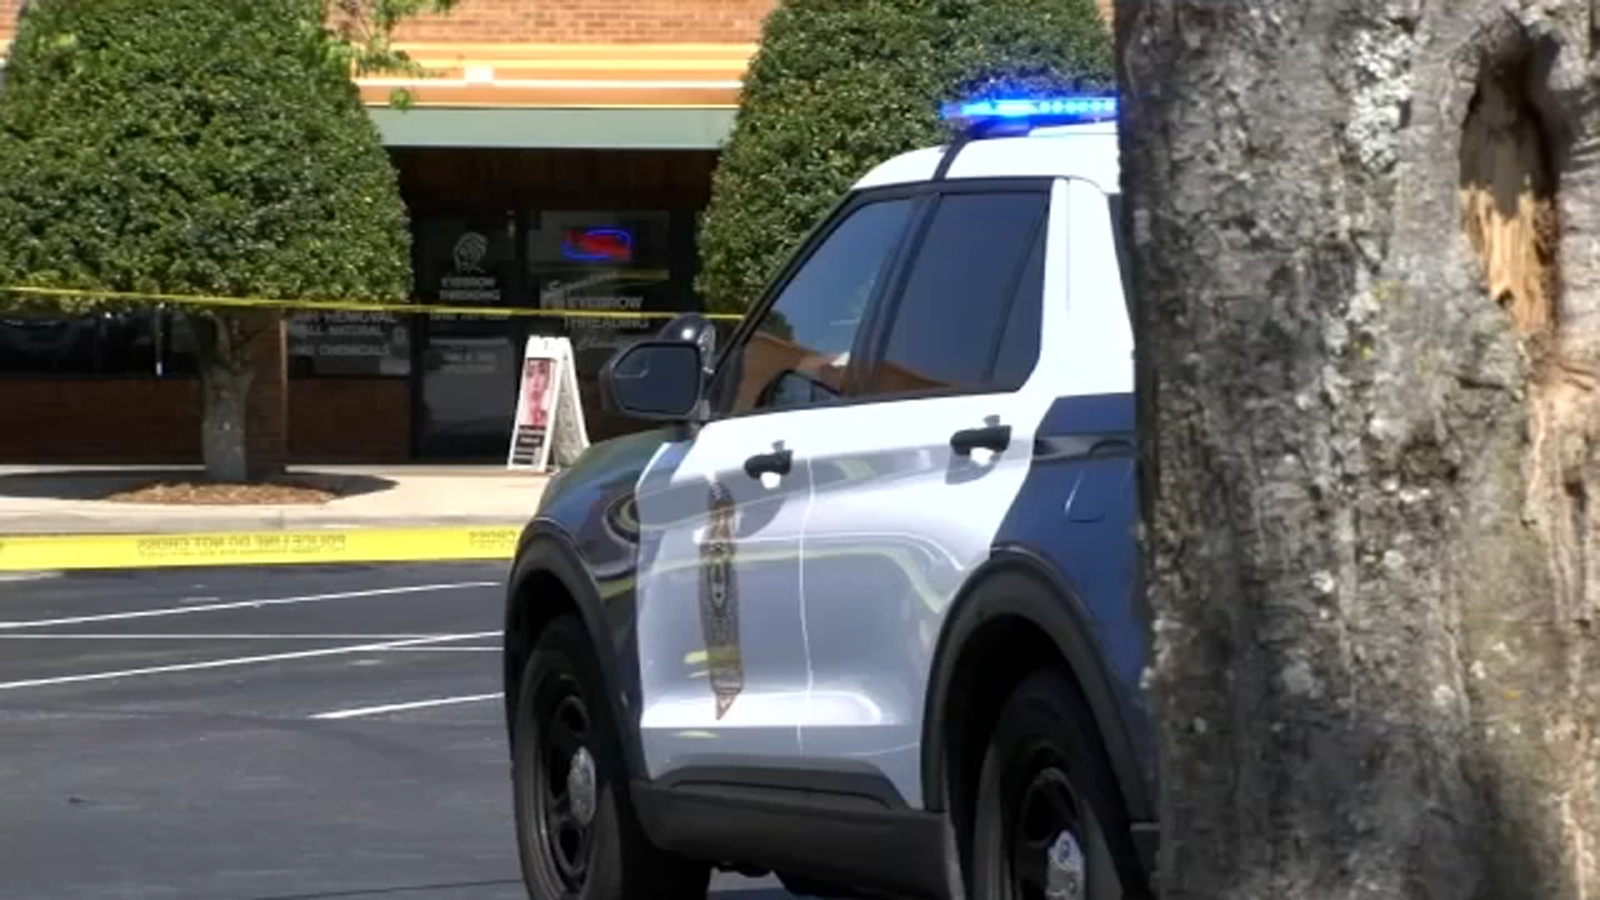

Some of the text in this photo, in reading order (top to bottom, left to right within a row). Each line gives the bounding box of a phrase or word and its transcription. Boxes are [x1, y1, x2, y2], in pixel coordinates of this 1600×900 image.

[440, 276, 497, 288] EYEBROW
[439, 289, 501, 301] THREADING
[568, 296, 645, 311] EYEBROW
[324, 311, 397, 323] REMOVAL
[564, 316, 650, 330] THREADING
[329, 324, 384, 336] NATURAL
[319, 343, 391, 355] CHEMICALS
